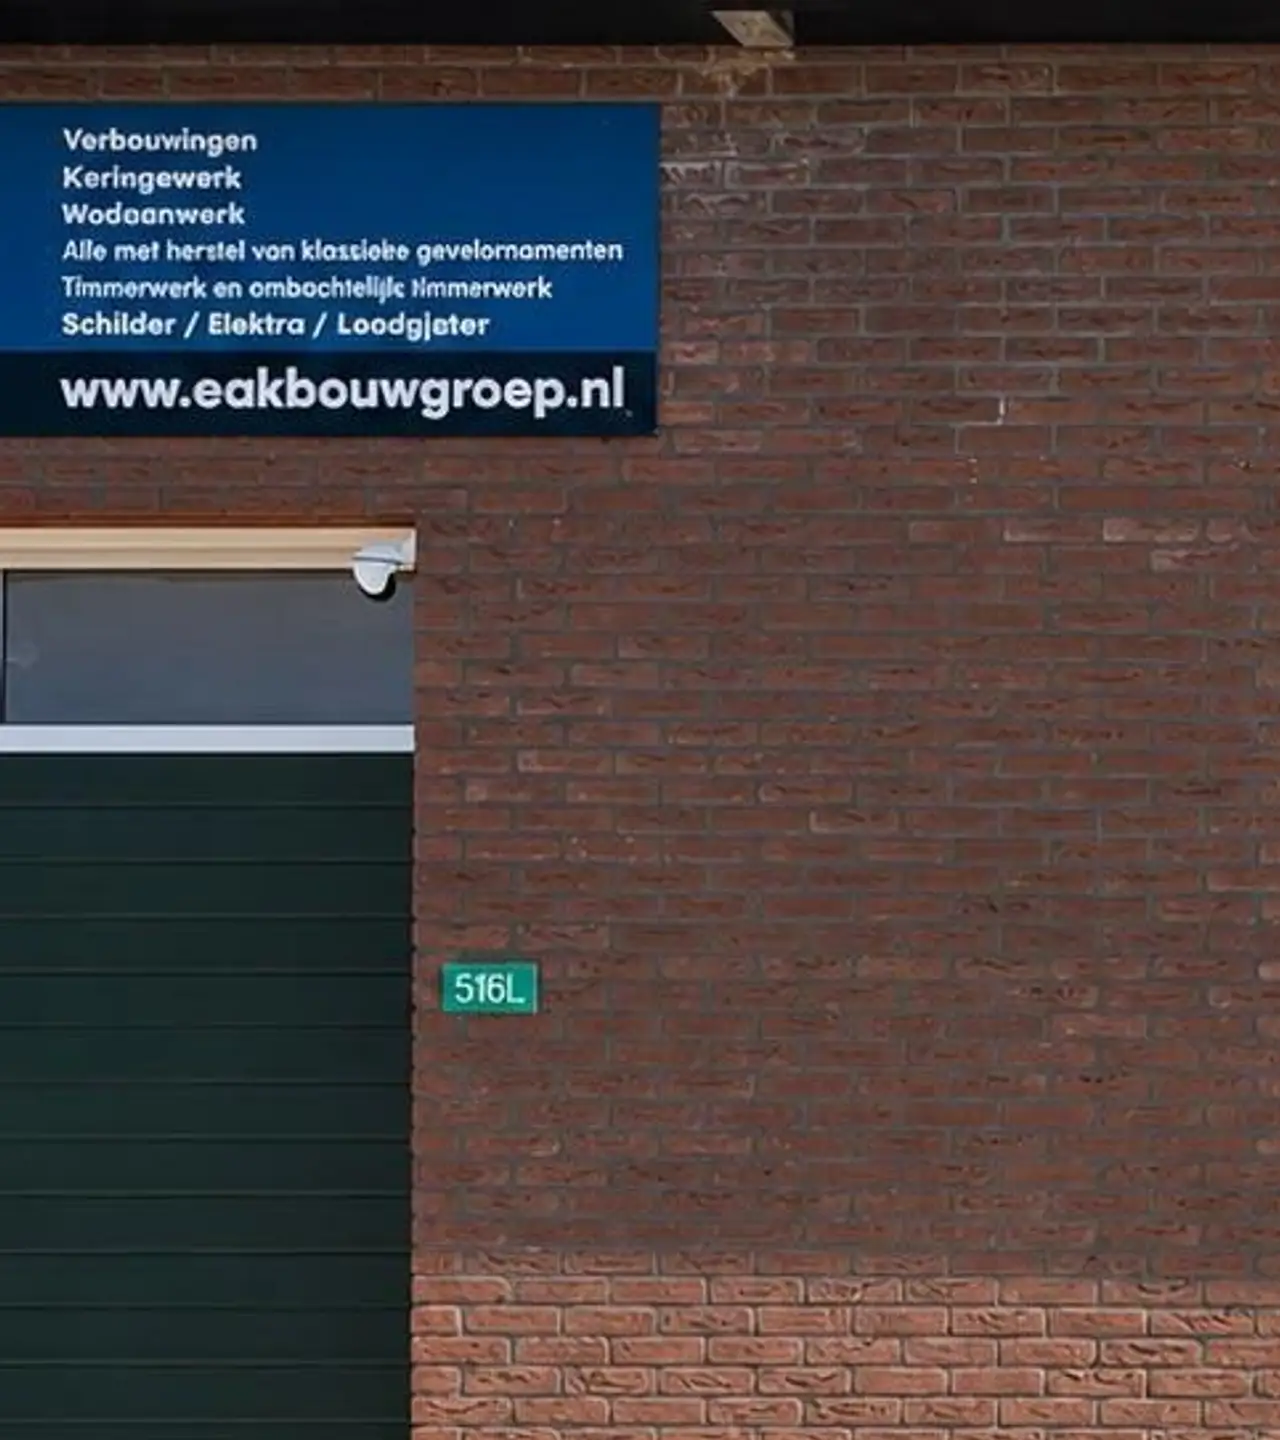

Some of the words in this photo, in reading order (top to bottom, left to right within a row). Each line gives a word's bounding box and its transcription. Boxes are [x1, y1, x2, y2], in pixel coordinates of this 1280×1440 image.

[63, 127, 258, 158] Verbouwingen
[62, 164, 242, 195] Keringewerk
[114, 240, 160, 262] met
[166, 239, 246, 262] herstel
[61, 276, 207, 299] Timmerwerk
[212, 281, 243, 299] en
[62, 311, 177, 335] Schilder
[183, 311, 200, 340] /
[208, 311, 305, 335] Elektra
[311, 311, 328, 340] /
[60, 366, 625, 419] www.eakbouwgroep.nl
[455, 972, 526, 1004] 516L
